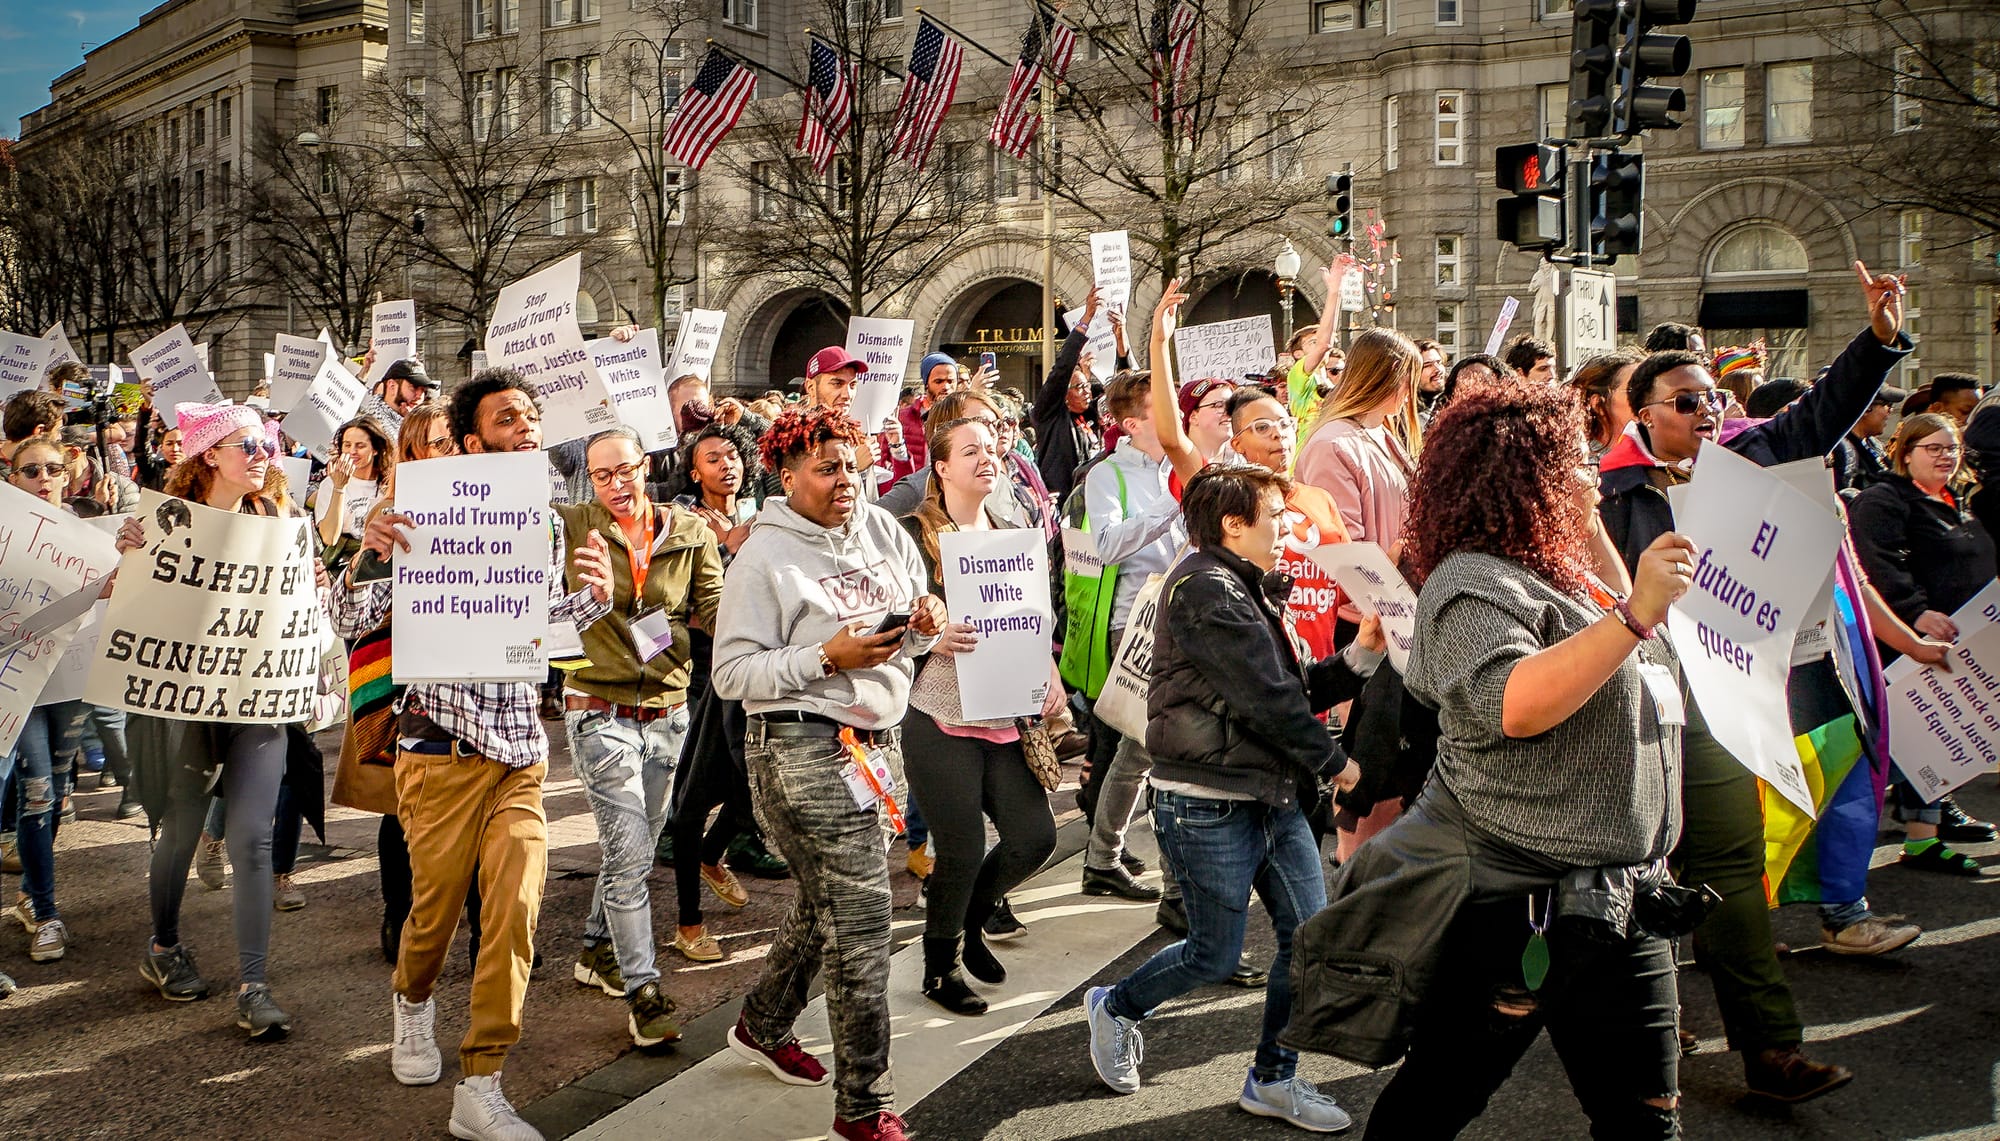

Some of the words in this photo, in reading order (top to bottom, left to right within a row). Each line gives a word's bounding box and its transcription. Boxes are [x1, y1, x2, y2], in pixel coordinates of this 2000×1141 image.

[524, 292, 547, 309] Stop
[1576, 279, 1595, 300] THRU
[380, 324, 401, 333] White
[491, 314, 528, 339] Donald
[529, 301, 571, 322] Trump's
[15, 345, 31, 356] The
[282, 344, 320, 358] Dismantle
[374, 337, 410, 347] Supremacy
[503, 331, 538, 356] Attack
[540, 331, 556, 346] on
[857, 333, 904, 346] Dismantle
[0, 356, 29, 370] Future
[29, 361, 38, 371] is
[141, 339, 182, 366] Dismantle
[288, 358, 311, 369] White
[543, 349, 588, 371] Justice
[594, 347, 648, 368] Dismantle
[866, 351, 893, 364] White
[1, 370, 28, 383] Queer
[154, 356, 181, 374] White
[608, 368, 641, 385] White
[151, 363, 198, 392] Supremacy
[326, 370, 356, 401] Dismantle
[537, 370, 589, 400] quality!
[856, 372, 899, 385] upremacy
[326, 387, 345, 407] White
[611, 385, 657, 406] premacy
[452, 480, 491, 501] Stop
[470, 506, 541, 531] Trump's
[28, 511, 100, 593] Trump
[430, 536, 485, 555] Attack
[490, 540, 512, 555] on
[1751, 520, 1779, 561] El
[959, 552, 1034, 575] Dismantle
[398, 564, 480, 587] Freedom,
[483, 564, 545, 584] Justice
[979, 582, 1023, 603] White
[1287, 585, 1337, 614] ange
[1692, 548, 1756, 616] futuro
[1756, 600, 1781, 632] es
[411, 594, 445, 615] and
[450, 594, 530, 619] Equality!
[207, 608, 264, 638] MY
[281, 605, 319, 638] OFF
[105, 629, 247, 676] HANDS
[1697, 621, 1754, 676] queer
[251, 647, 316, 678] TINY
[1958, 648, 2000, 691] Donald
[124, 675, 228, 717] YOUR
[1954, 675, 1989, 715] Attack
[1984, 714, 2000, 731] on
[1919, 667, 1963, 724] Freedom,
[1960, 722, 1998, 764] Justice
[1906, 688, 1932, 713] and
[1924, 709, 1973, 767] Equality!
